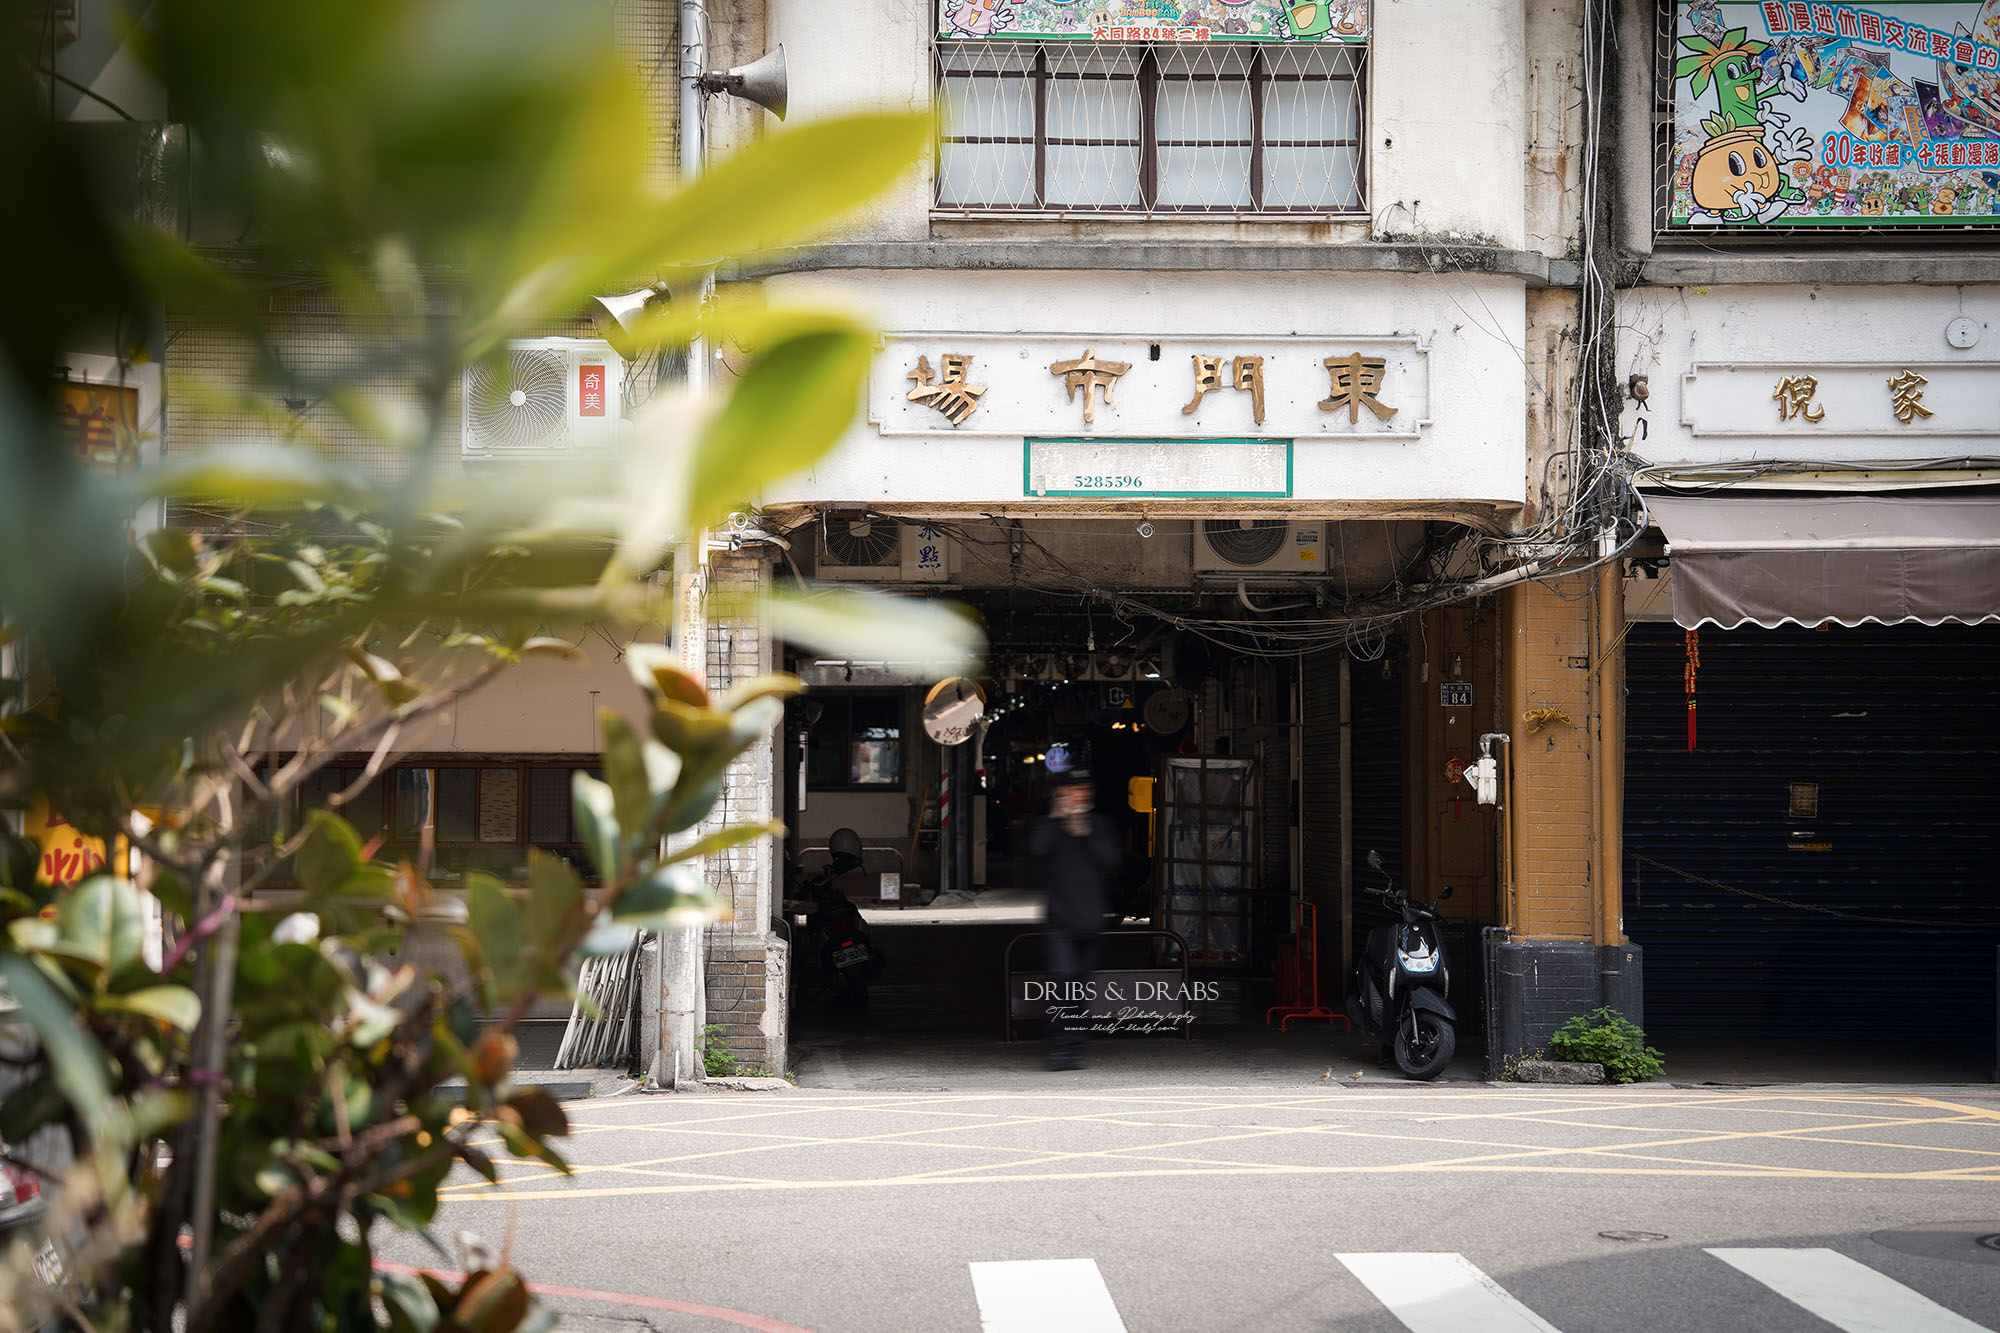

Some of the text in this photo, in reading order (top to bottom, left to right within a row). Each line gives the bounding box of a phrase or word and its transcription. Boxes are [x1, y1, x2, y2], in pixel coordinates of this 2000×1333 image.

[1763, 1, 1998, 68] 動漫迷休閒交流聚會的
[583, 372, 601, 410] 奇美
[1074, 475, 1143, 489] 5285596
[1451, 692, 1467, 704] 84
